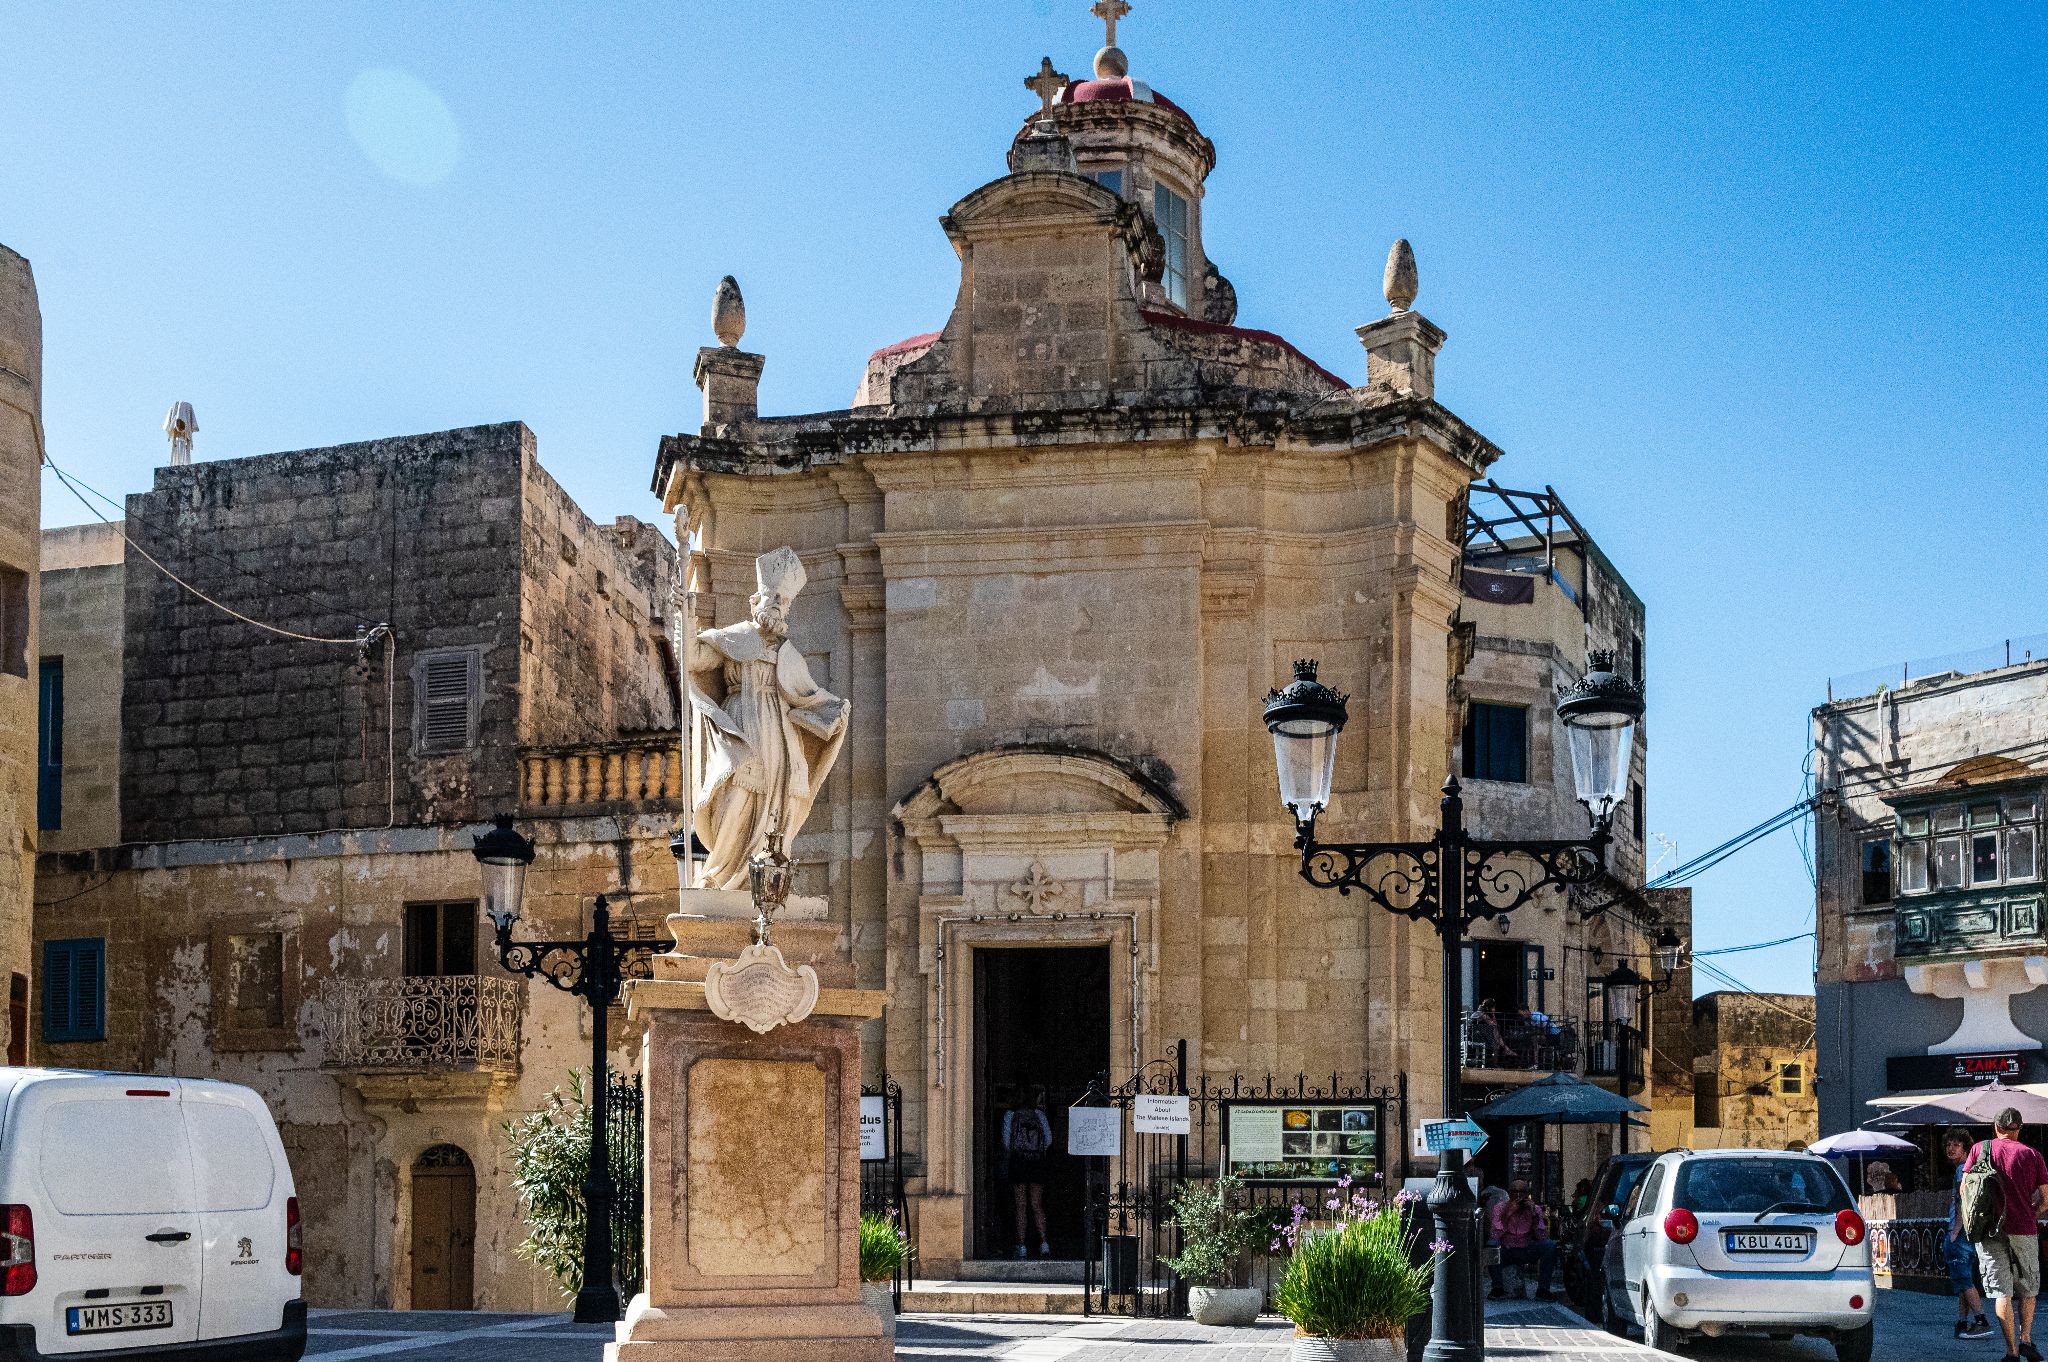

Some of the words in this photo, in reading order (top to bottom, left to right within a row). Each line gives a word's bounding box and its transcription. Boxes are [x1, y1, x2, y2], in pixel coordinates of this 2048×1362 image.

[1530, 969, 1554, 979] AT
[1965, 1057, 2009, 1072] ZAIKA
[860, 1115, 882, 1125] dus
[1737, 1236, 1768, 1249] KBU
[1774, 1236, 1803, 1249] 401
[83, 1308, 123, 1328] WMS
[131, 1305, 166, 1324] 333
